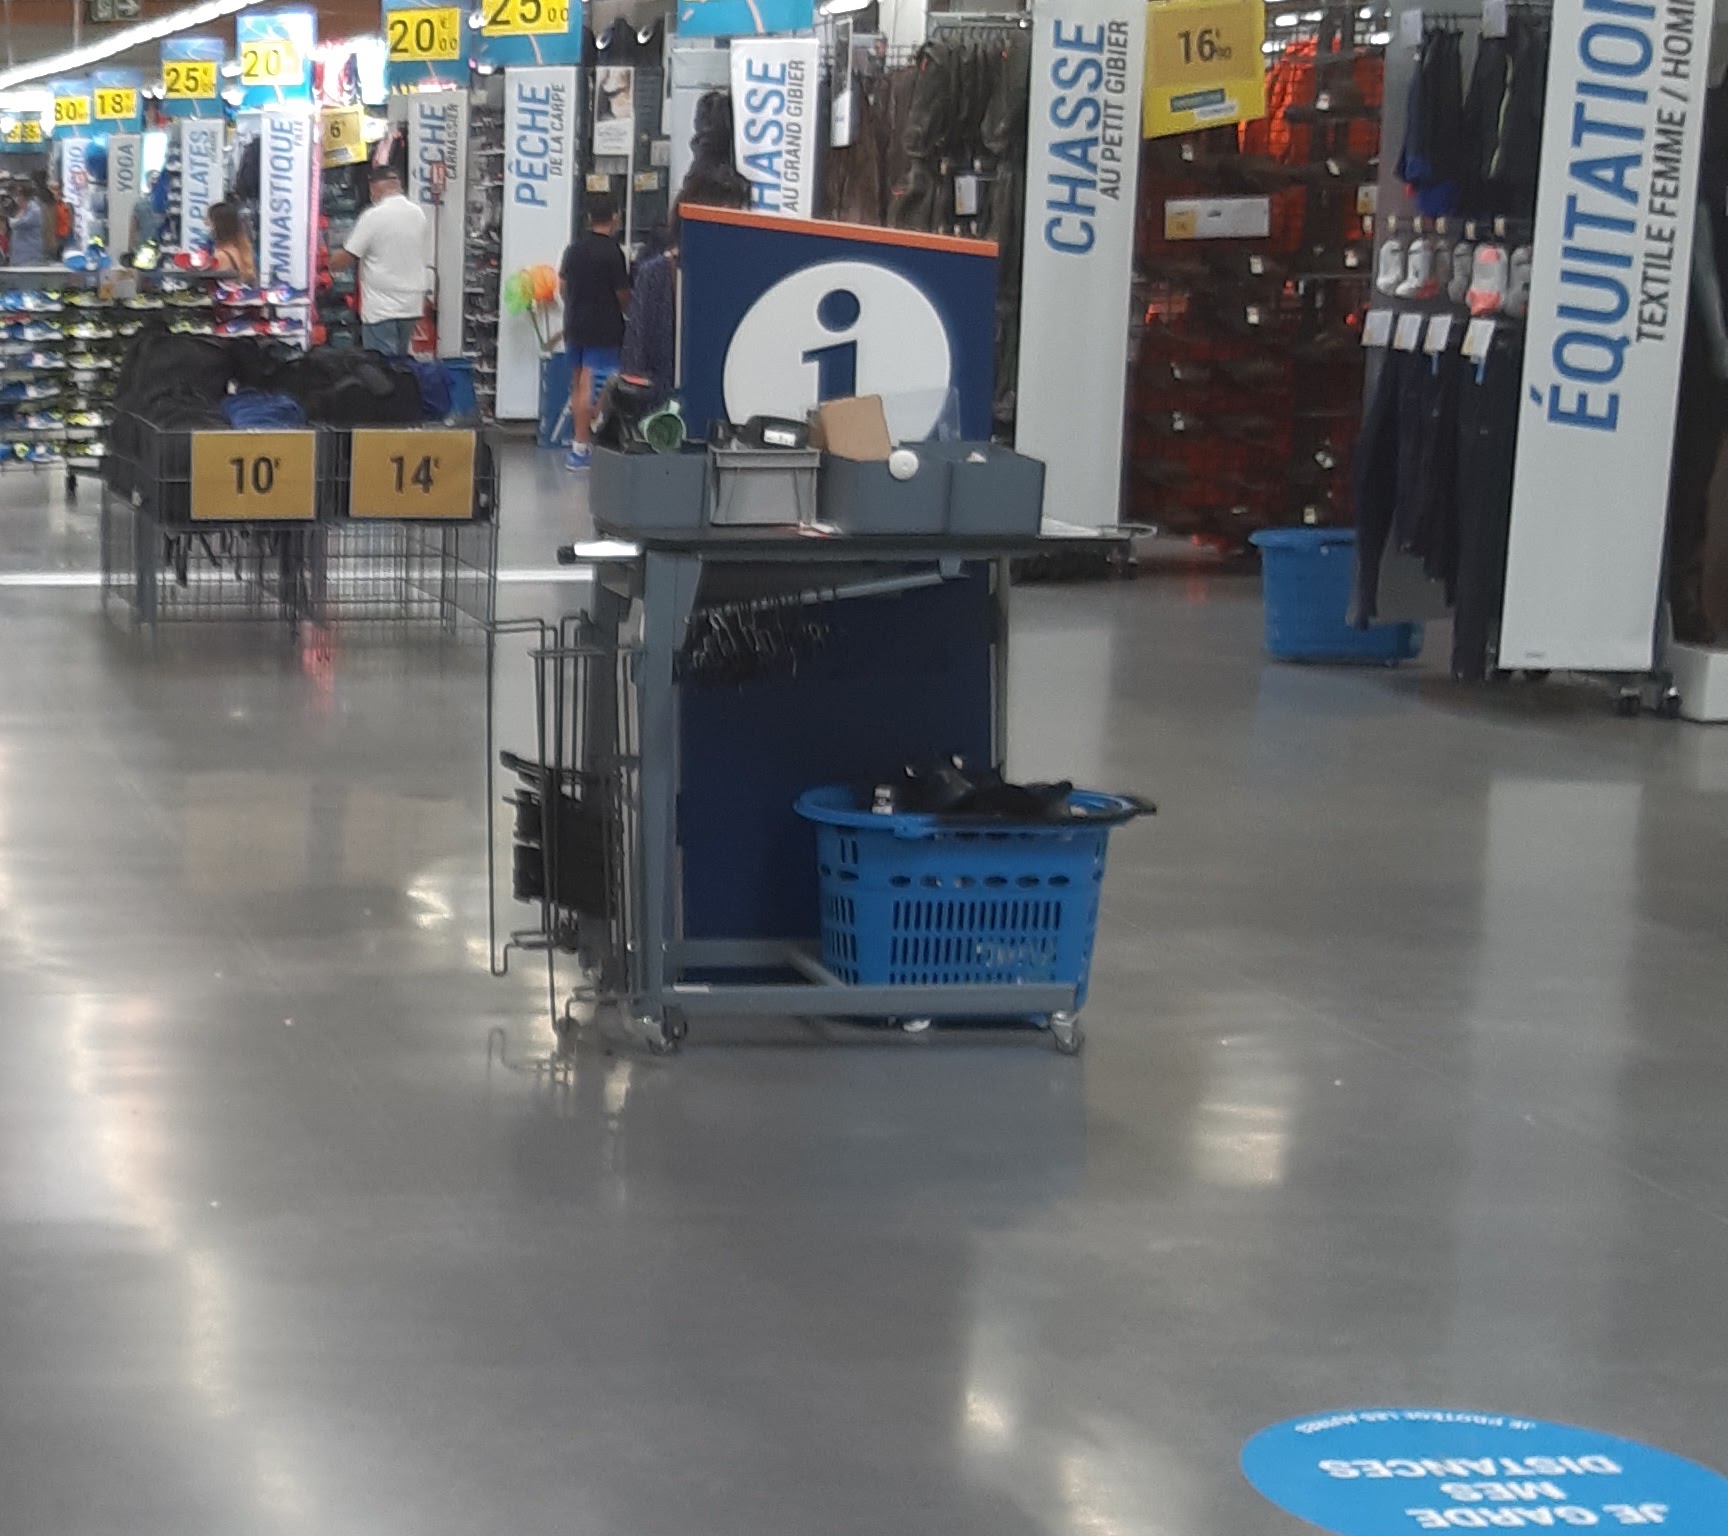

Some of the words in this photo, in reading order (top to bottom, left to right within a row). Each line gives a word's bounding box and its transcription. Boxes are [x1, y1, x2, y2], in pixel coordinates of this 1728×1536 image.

[389, 18, 435, 52] 20
[1107, 19, 1131, 94] GIBIER
[165, 67, 200, 93] 25
[786, 59, 805, 114] GIBIER
[550, 83, 566, 132] CARPE
[1105, 96, 1126, 165] PETIT
[507, 82, 550, 209] PÊCHE
[550, 135, 564, 155] LA
[741, 58, 787, 213] HASSE
[783, 116, 802, 179] GRAND
[1044, 18, 1106, 255] CHASSE
[116, 143, 135, 193] YOGA
[187, 130, 210, 220] PILATES
[1099, 170, 1122, 201] AU
[1649, 109, 1687, 219] FEMME
[782, 182, 798, 213] AU
[1637, 223, 1675, 344] TEXTILE
[1317, 1455, 1623, 1479] DISTANCES
[1439, 1480, 1568, 1502] MES
[1405, 1505, 1599, 1530] GARDE
[1601, 1503, 1668, 1526] JE
